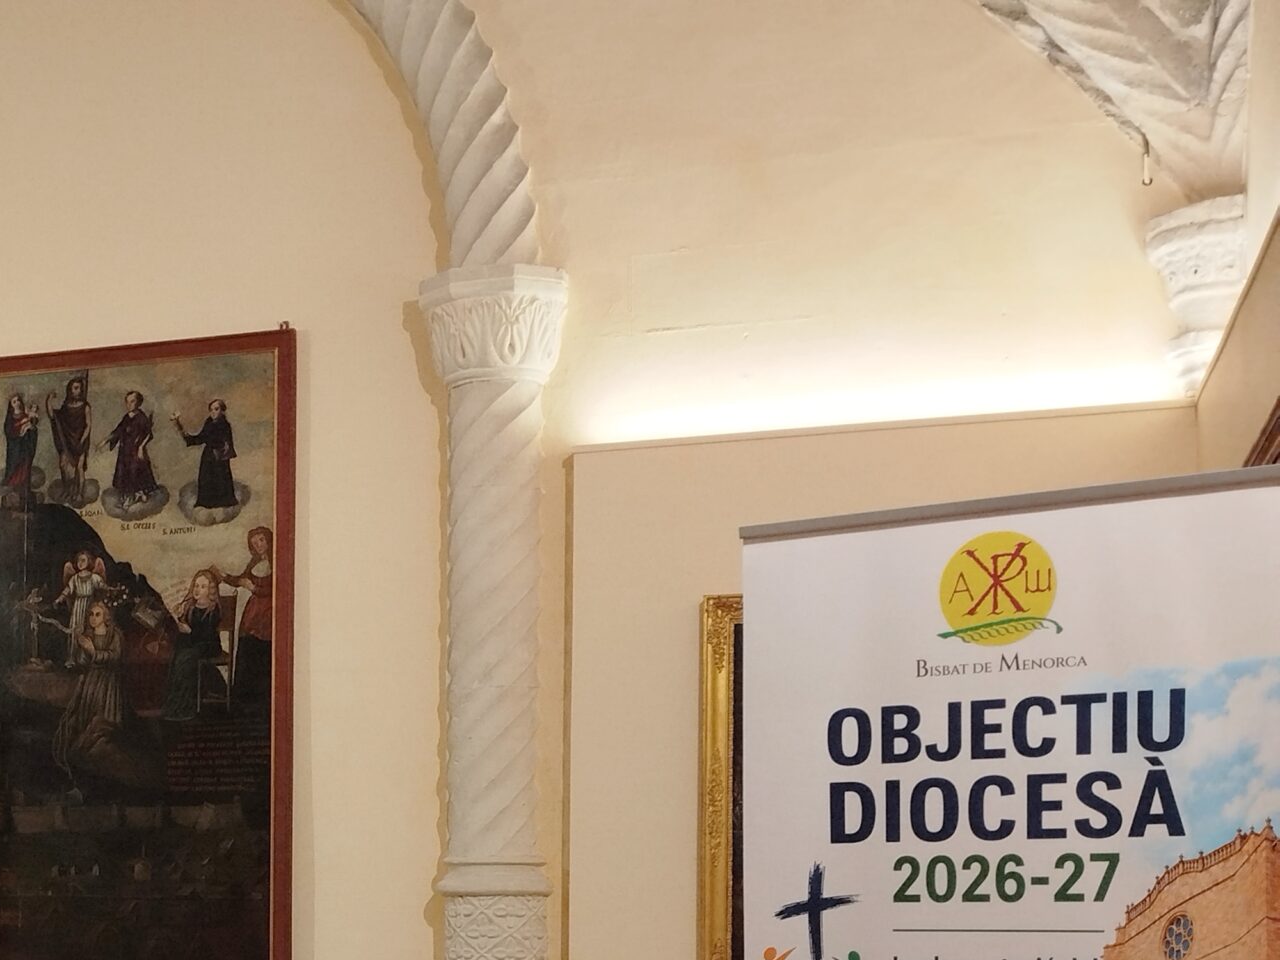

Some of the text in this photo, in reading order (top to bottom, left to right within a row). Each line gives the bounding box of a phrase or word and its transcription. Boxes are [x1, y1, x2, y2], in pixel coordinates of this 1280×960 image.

[827, 687, 1186, 767] OBJECTIU
[829, 756, 1186, 845] DIOCESÀ
[892, 852, 1120, 904] 2026-27
